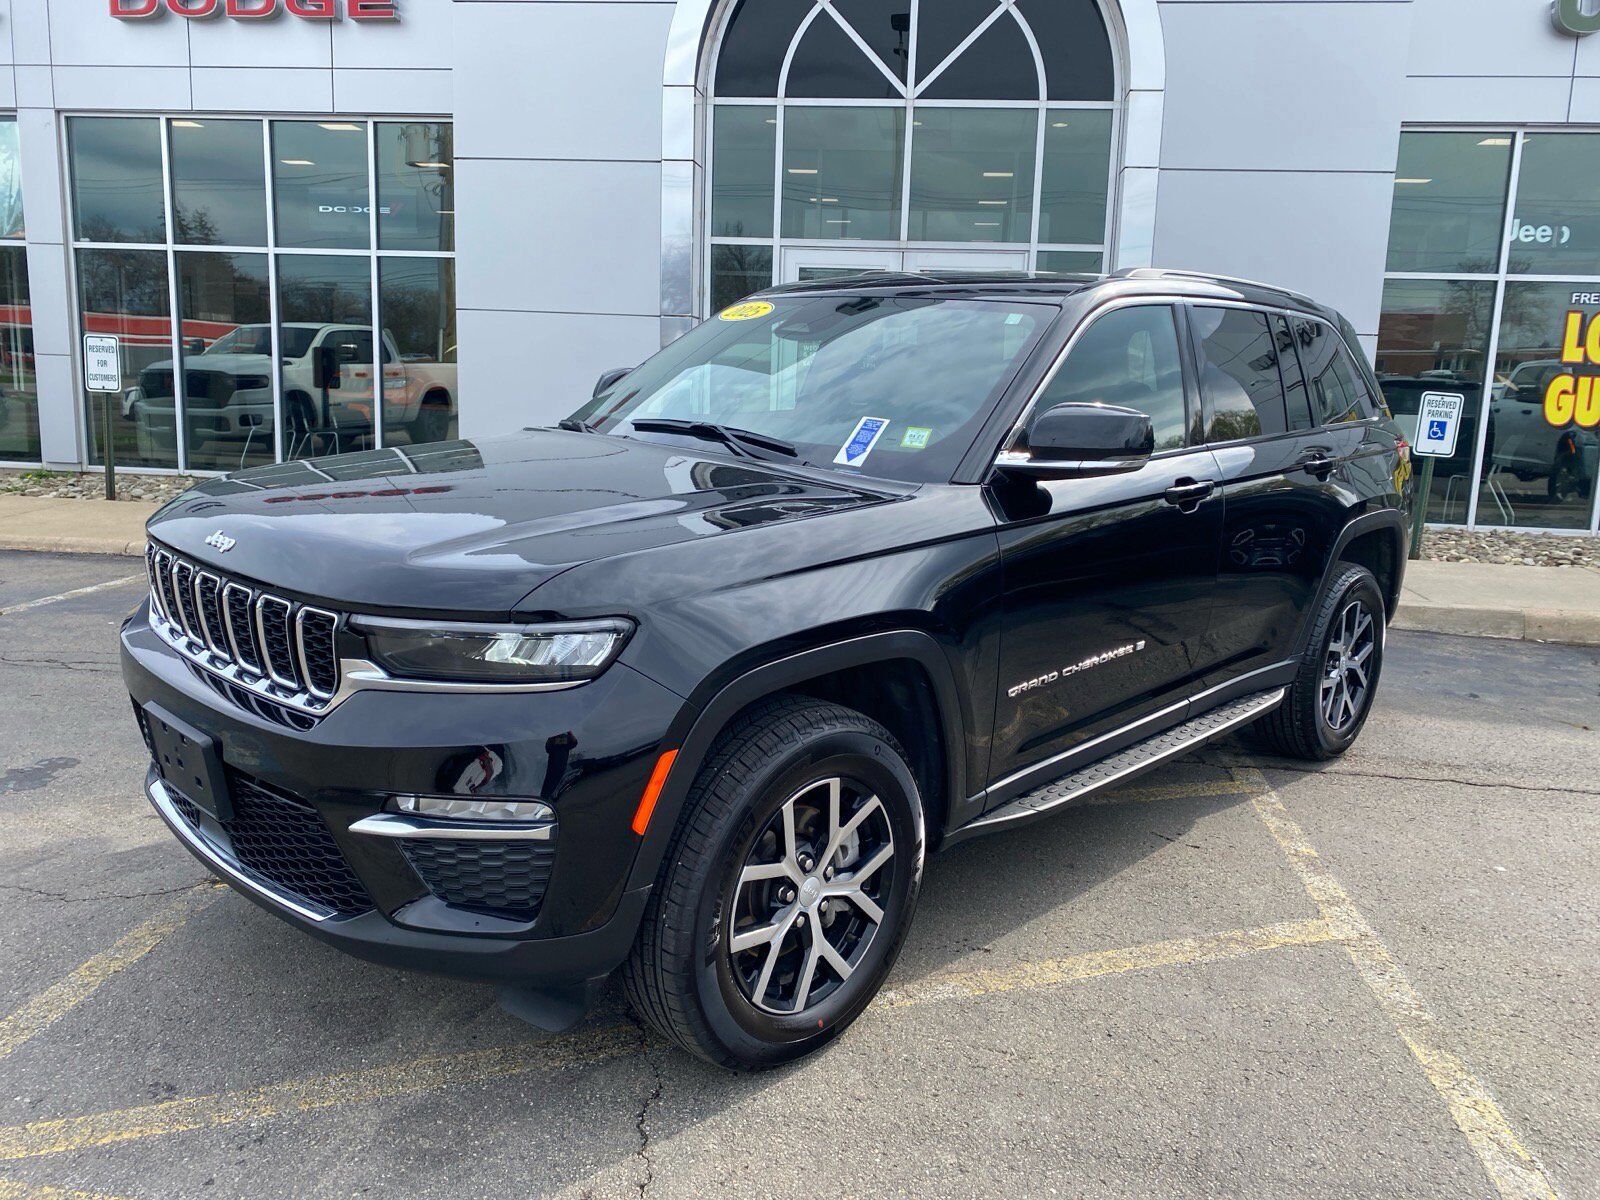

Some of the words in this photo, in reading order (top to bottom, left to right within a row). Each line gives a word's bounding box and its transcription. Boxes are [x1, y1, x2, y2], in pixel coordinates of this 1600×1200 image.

[89, 345, 115, 353] RESERVED
[89, 373, 117, 382] CUSTOMERS
[1426, 399, 1457, 410] RESERVED
[1427, 409, 1454, 419] PARKING
[204, 529, 236, 553] Jeep
[1007, 671, 1059, 697] GRAND
[1062, 644, 1134, 676] CHEROKEE
